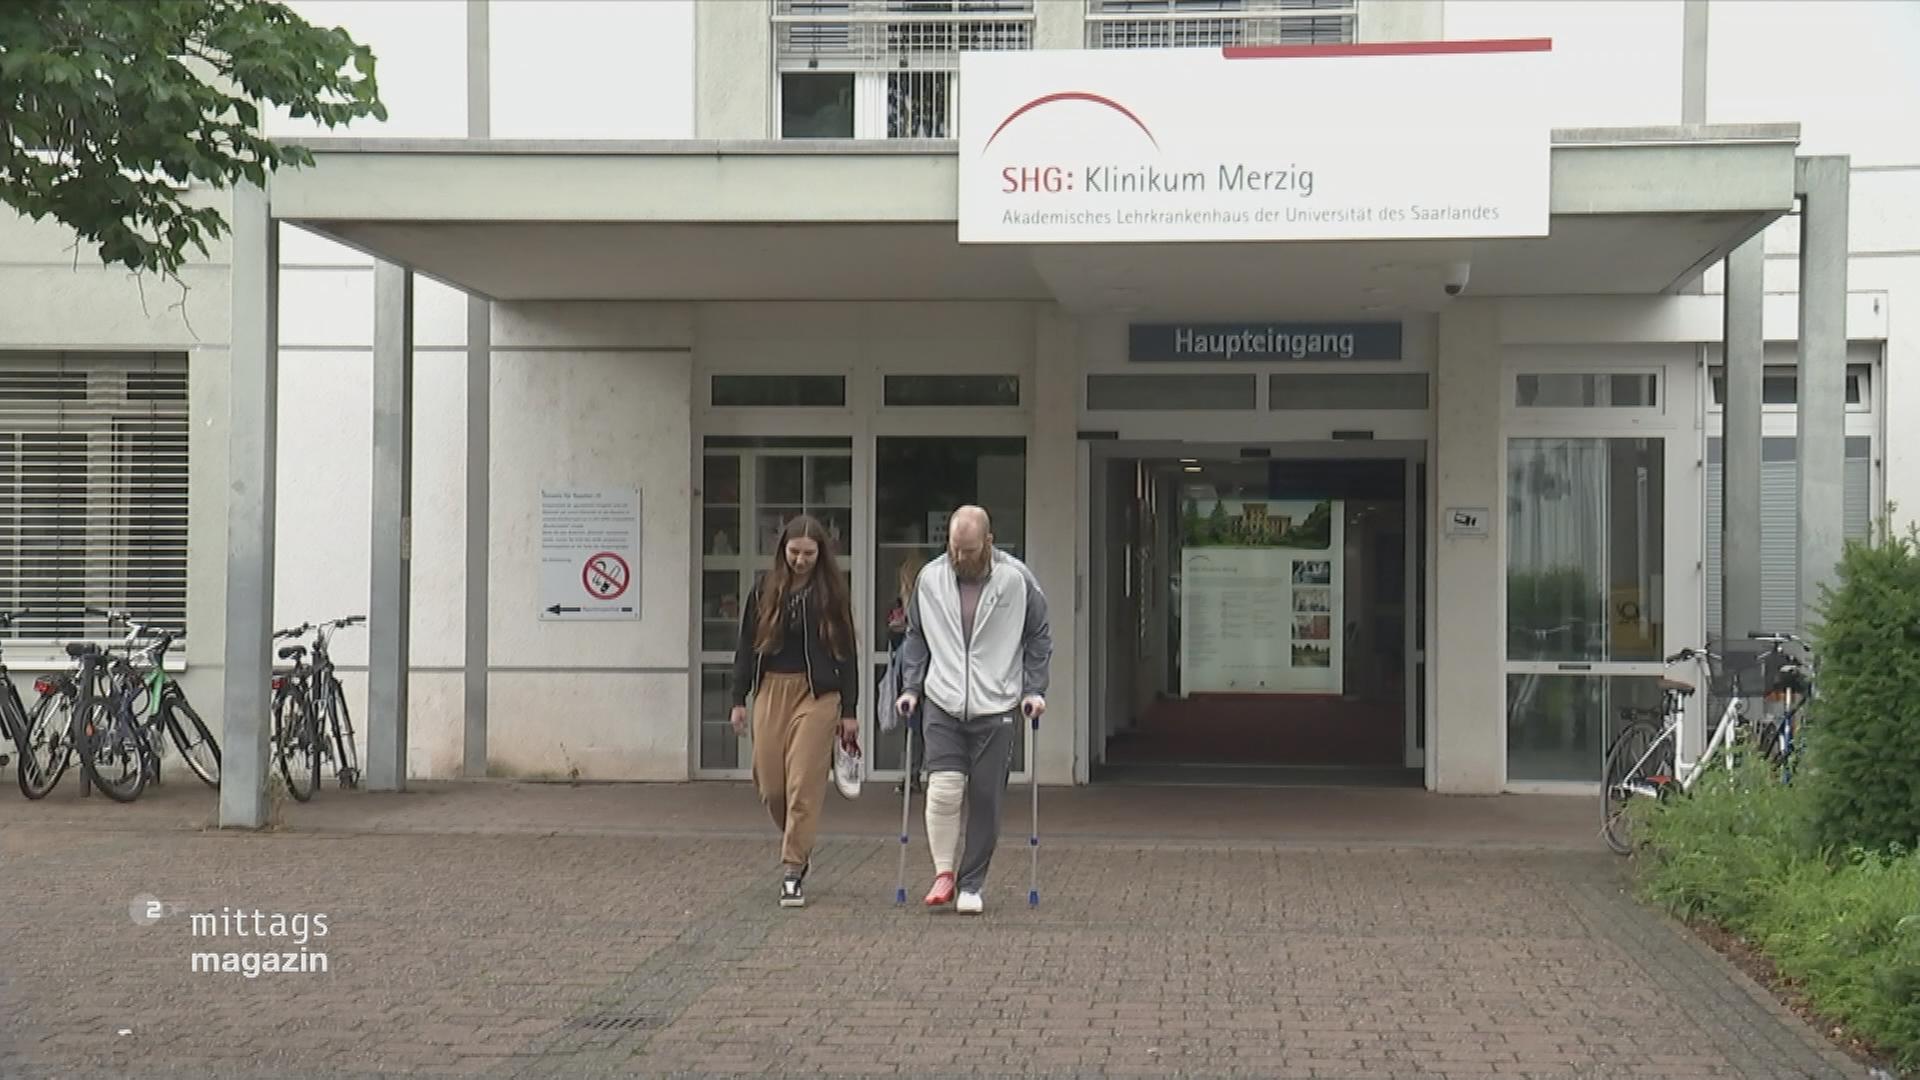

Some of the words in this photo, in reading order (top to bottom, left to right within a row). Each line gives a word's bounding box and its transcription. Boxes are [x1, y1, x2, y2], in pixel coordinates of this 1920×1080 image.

[1002, 166, 1074, 193] SHG:
[1085, 165, 1206, 193] Klinikum
[1219, 163, 1314, 198] Merzig
[1002, 208, 1111, 225] Akademisches
[1117, 208, 1249, 225] Lehrkrankenhaus
[1255, 207, 1280, 223] der
[1286, 206, 1372, 223] Universität
[1379, 206, 1406, 221] des
[1411, 205, 1499, 221] Saarlandes
[1175, 328, 1355, 359] Haupteingang
